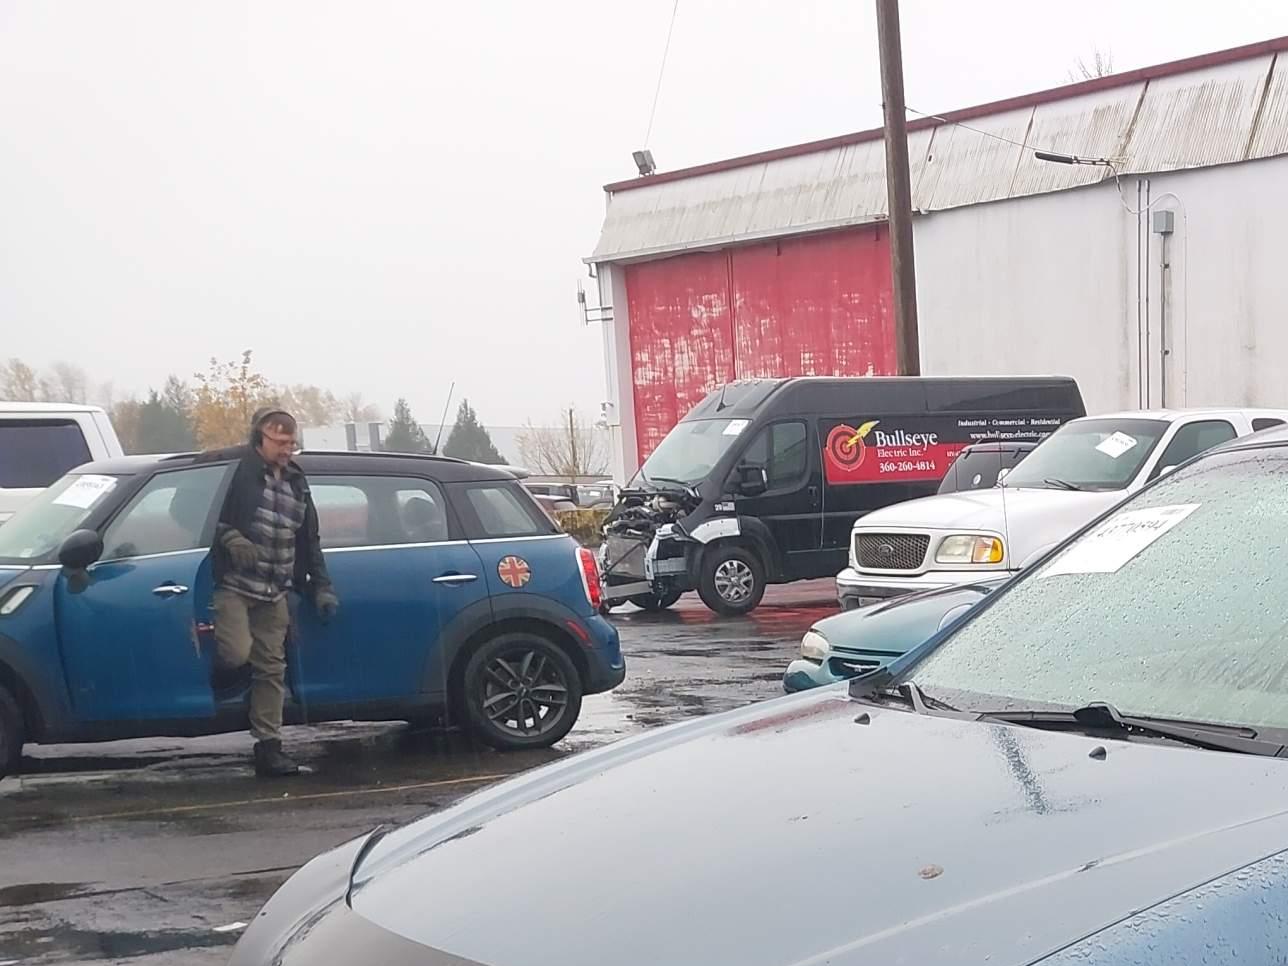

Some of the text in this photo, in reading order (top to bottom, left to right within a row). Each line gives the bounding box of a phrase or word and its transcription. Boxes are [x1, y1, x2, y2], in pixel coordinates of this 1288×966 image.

[875, 430, 937, 451] Bullseye
[877, 448, 924, 458] Electric Inc.
[879, 461, 935, 474] 360-260-4814
